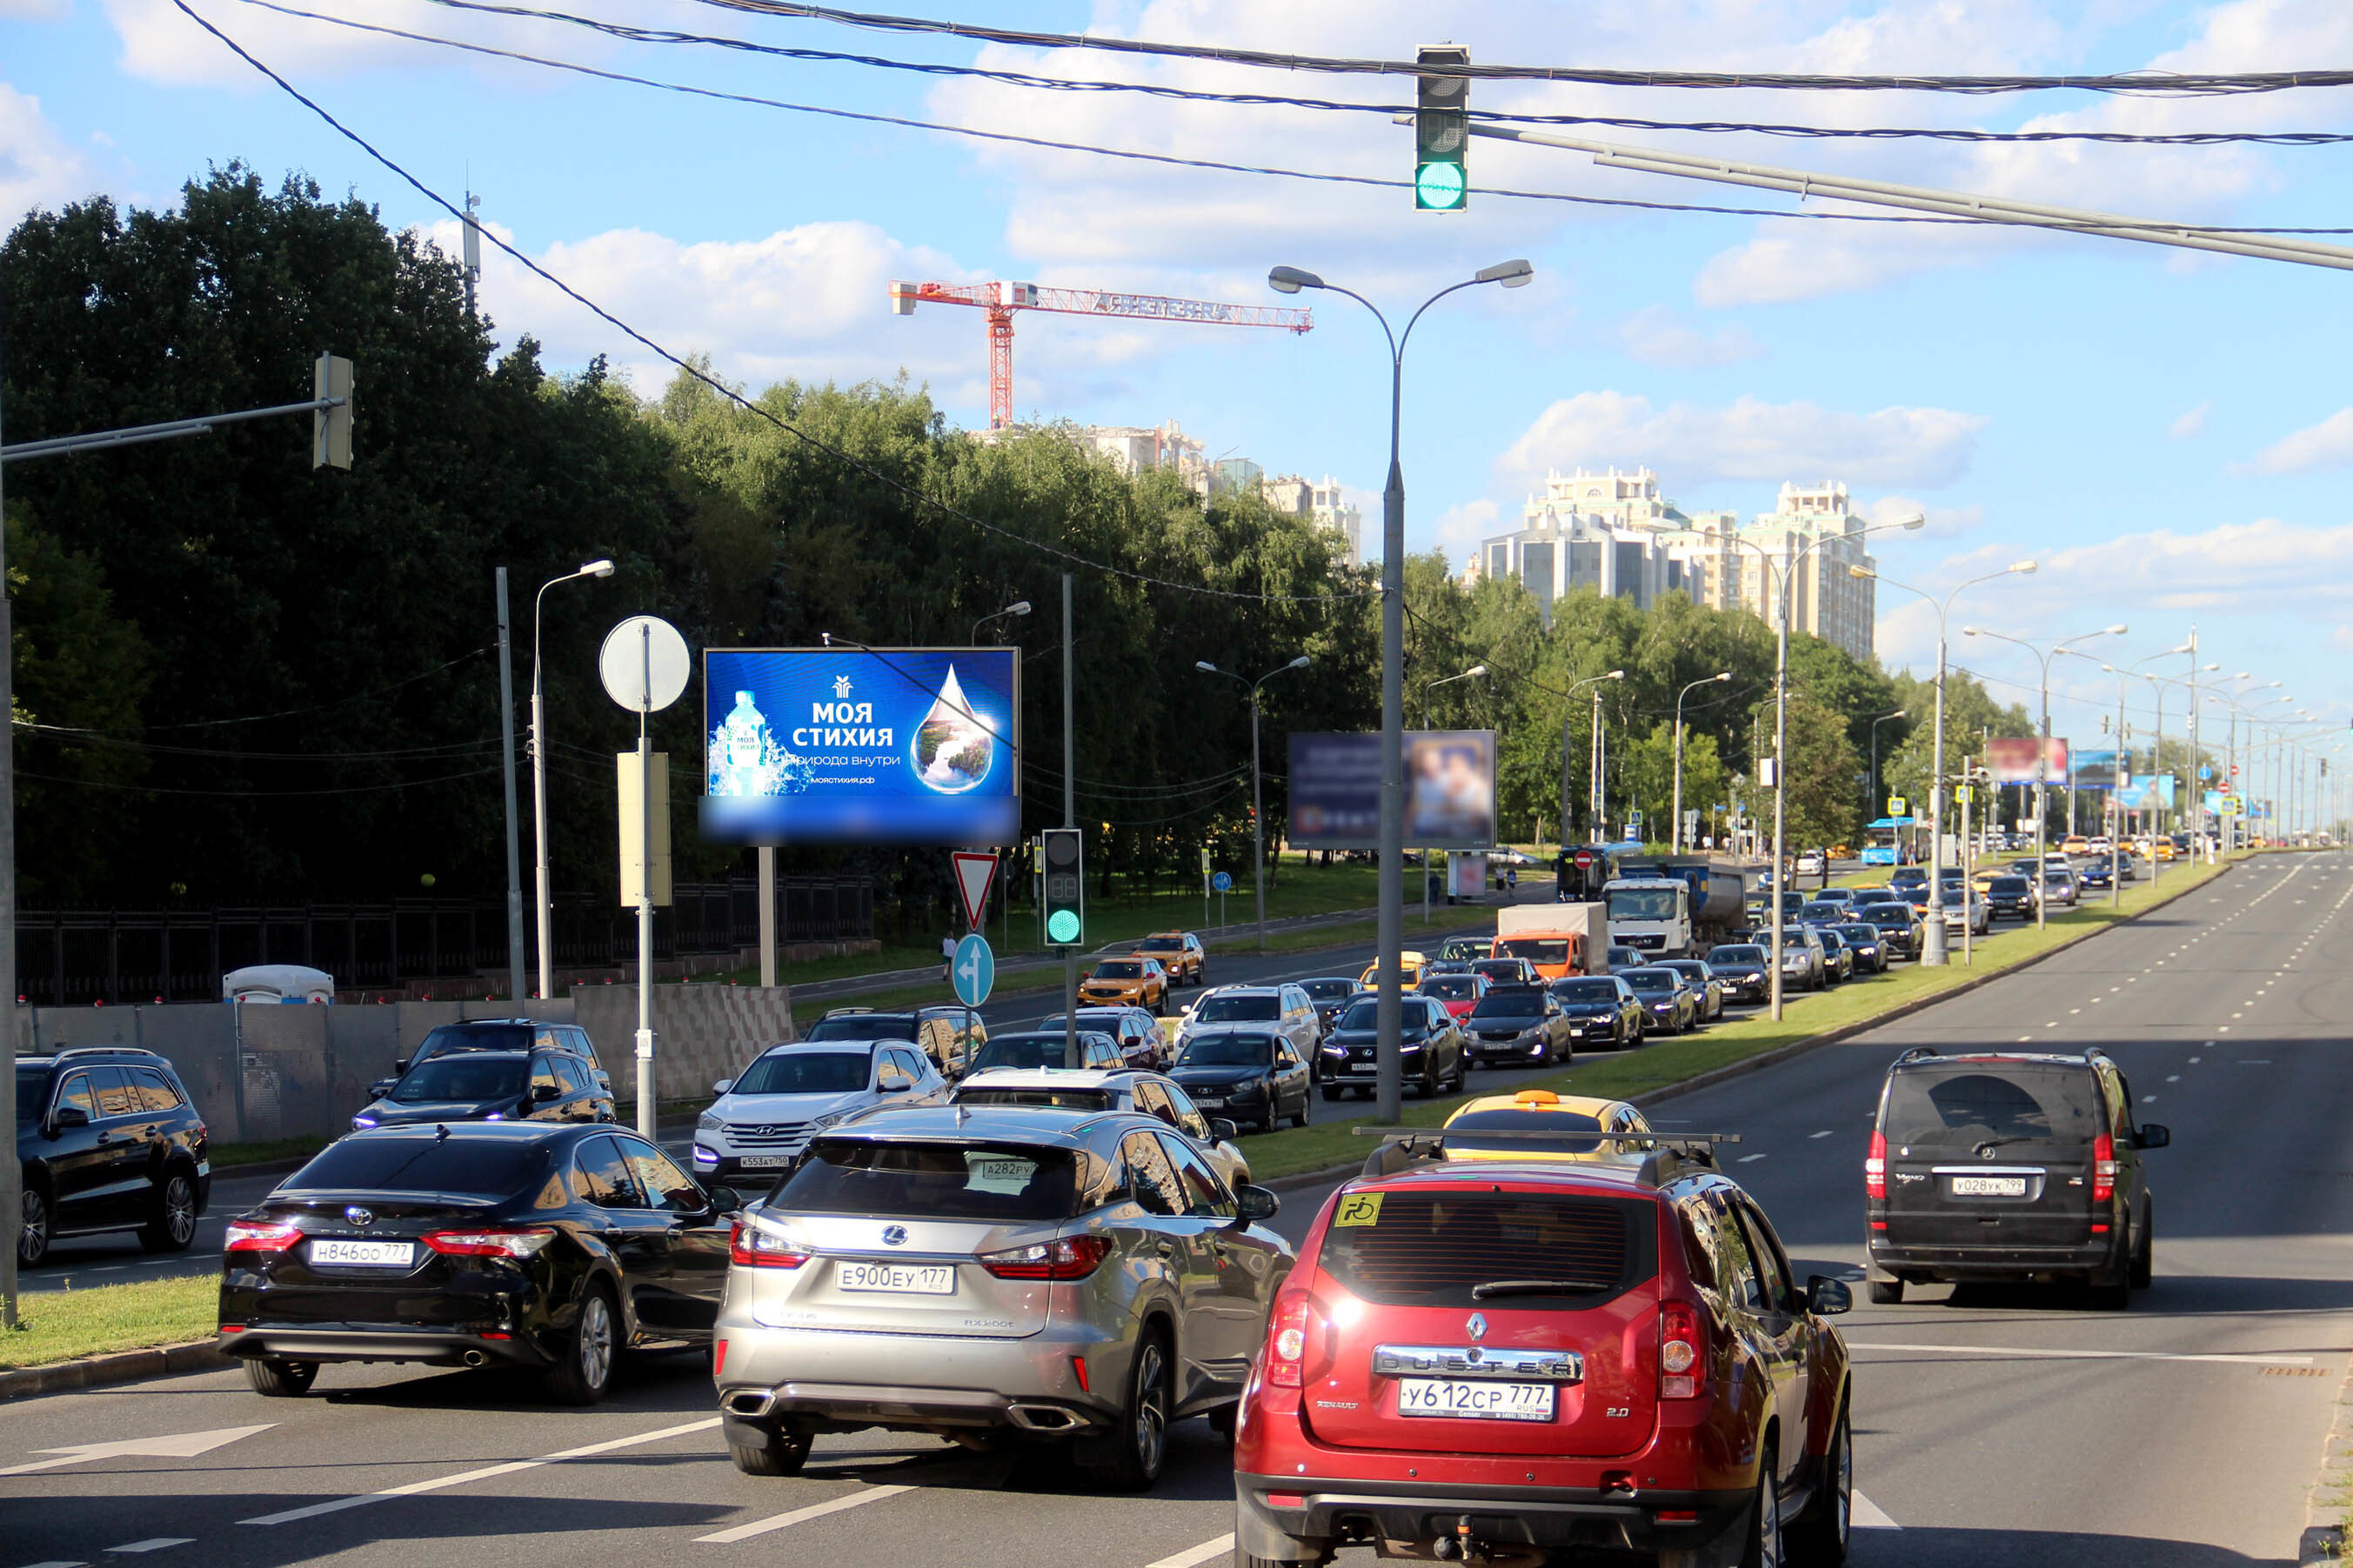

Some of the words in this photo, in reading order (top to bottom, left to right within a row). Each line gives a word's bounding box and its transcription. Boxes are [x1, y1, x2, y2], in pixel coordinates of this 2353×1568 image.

[812, 702, 872, 724] МОЯ
[792, 727, 892, 746] СТИХИЯ
[852, 756, 900, 767] внутри
[810, 776, 875, 784] моястихия.рф
[987, 1163, 1030, 1175] А282РУ
[1957, 1179, 2002, 1191] У028УК
[318, 1244, 380, 1260] Н846ОО
[384, 1244, 408, 1258] 777
[843, 1266, 915, 1287] Е900ЕУ
[919, 1268, 947, 1284] 177
[1381, 1357, 1571, 1375] DUSTER
[1409, 1384, 1502, 1409] У612СР
[1509, 1385, 1546, 1405] 777
[1316, 1400, 1359, 1410] RENAULT
[1607, 1407, 1629, 1418] 2.0
